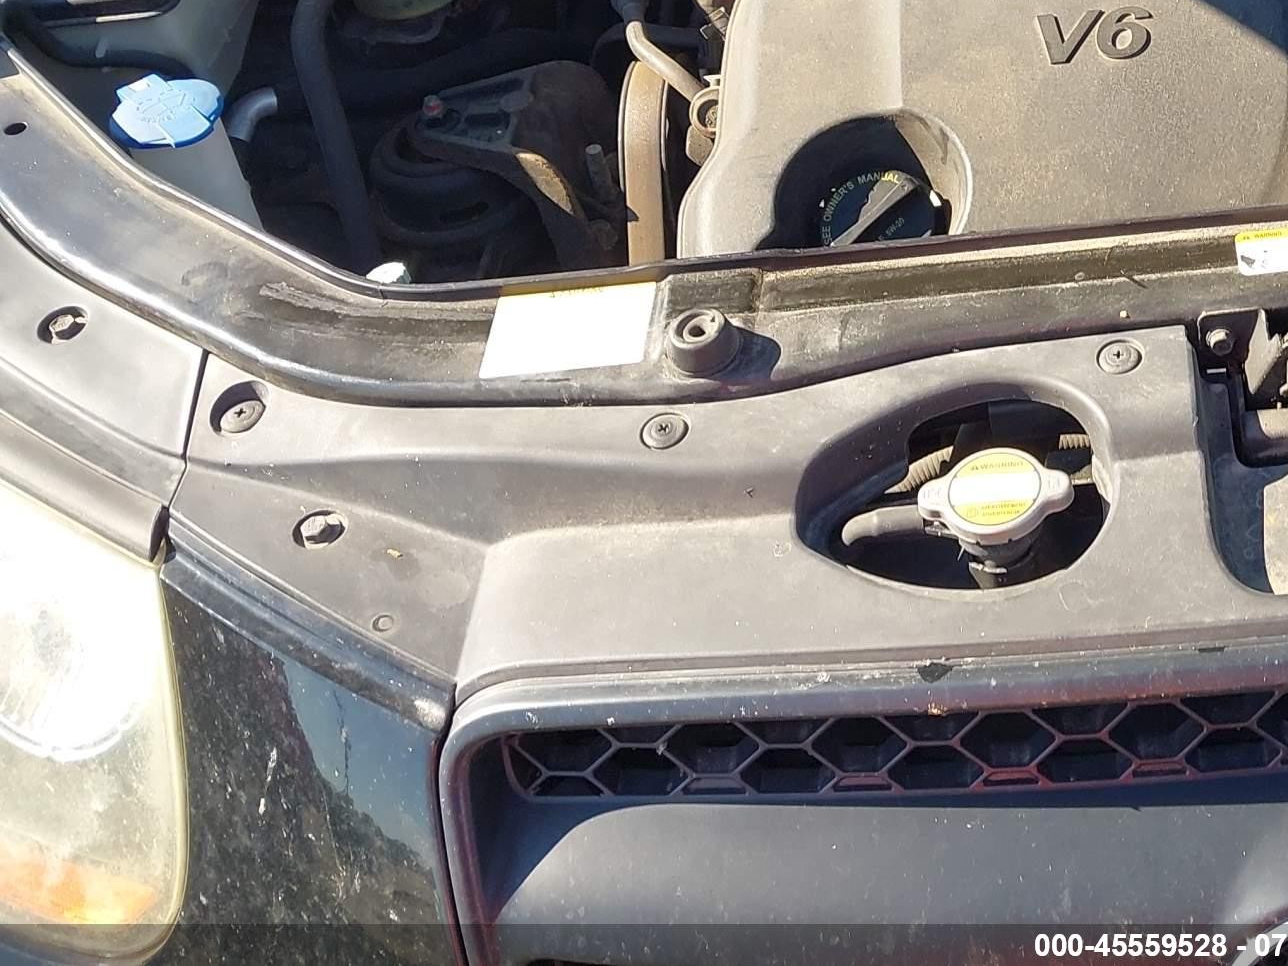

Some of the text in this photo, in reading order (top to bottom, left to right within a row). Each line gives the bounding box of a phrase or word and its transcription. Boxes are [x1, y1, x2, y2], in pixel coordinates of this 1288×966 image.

[1034, 6, 1154, 66] V6
[821, 170, 901, 246] SEE OWNER'S MANUAL
